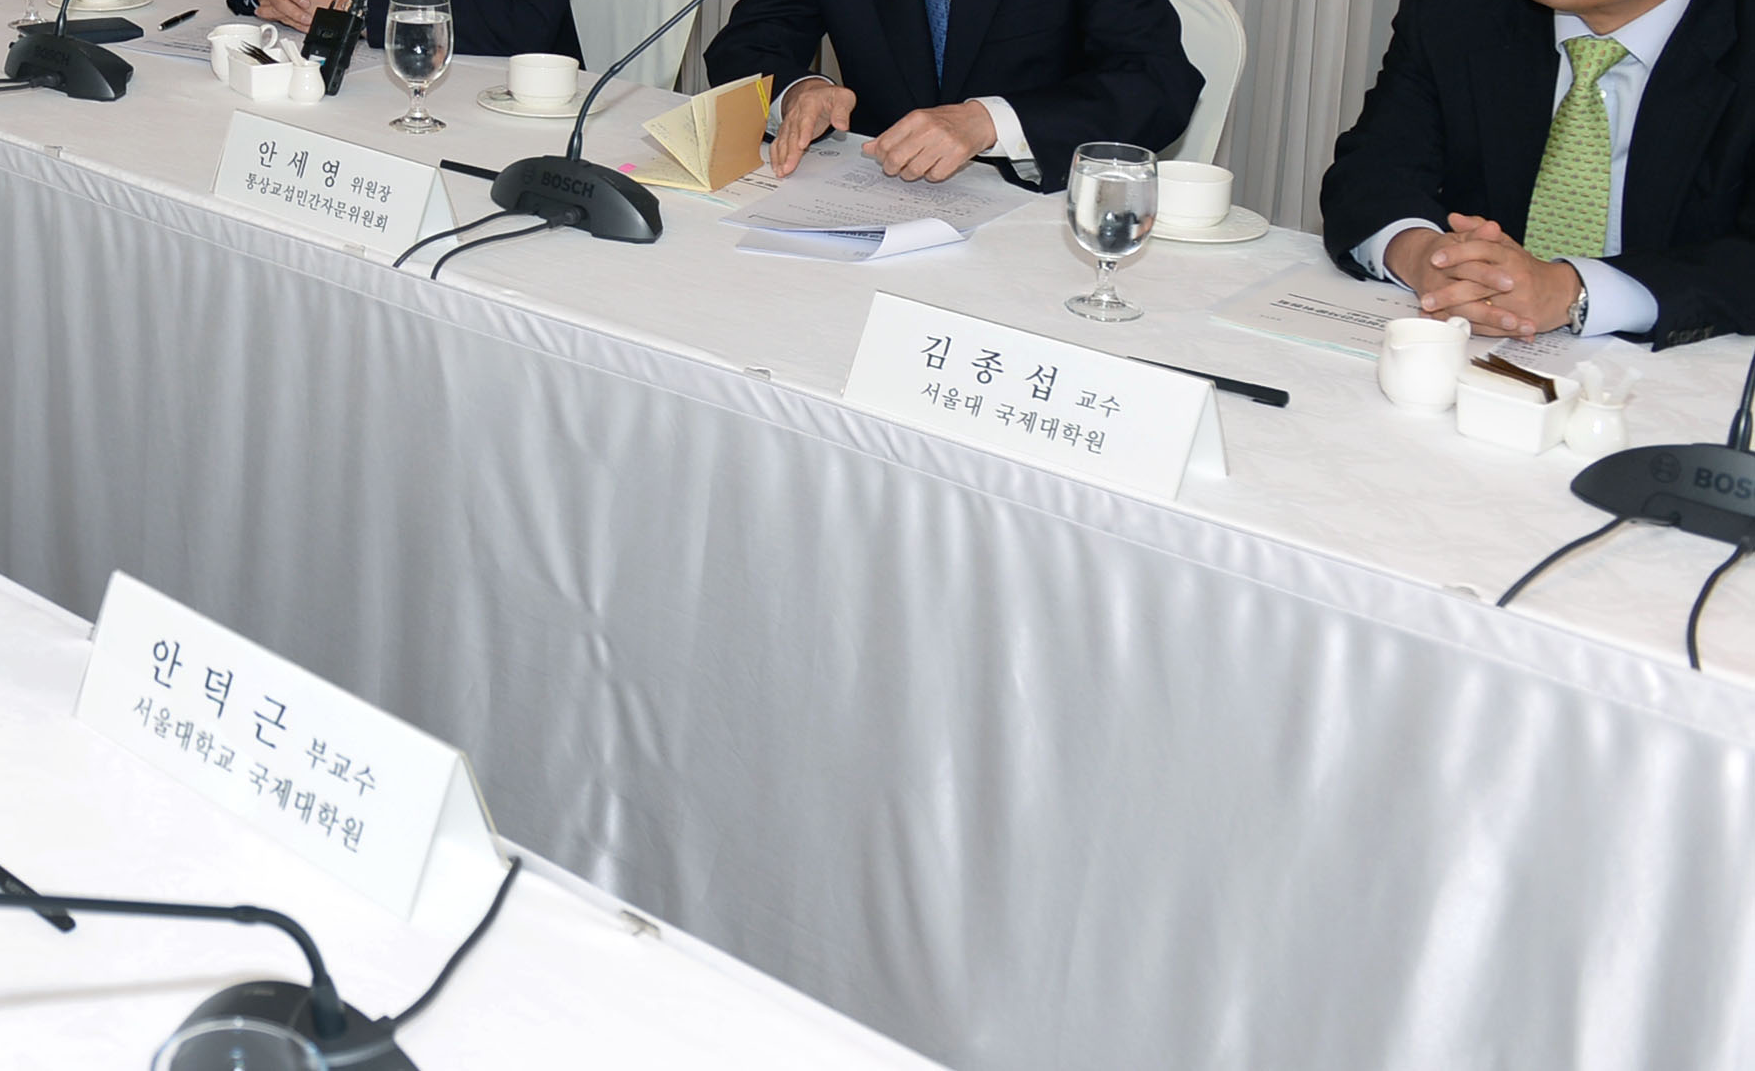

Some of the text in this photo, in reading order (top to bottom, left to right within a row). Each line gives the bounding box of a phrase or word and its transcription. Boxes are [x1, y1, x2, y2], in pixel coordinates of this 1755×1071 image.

[245, 173, 389, 233] 통상교섭민간자문위원회
[350, 176, 392, 203] 위원장
[541, 171, 595, 199] BOSCH
[921, 381, 1106, 455] 서울대 국제대학원
[1075, 389, 1122, 418] 교수
[1694, 466, 1755, 499] BOS
[133, 696, 365, 854] 서울대학교 국제대학원
[305, 736, 377, 797] 부교수
